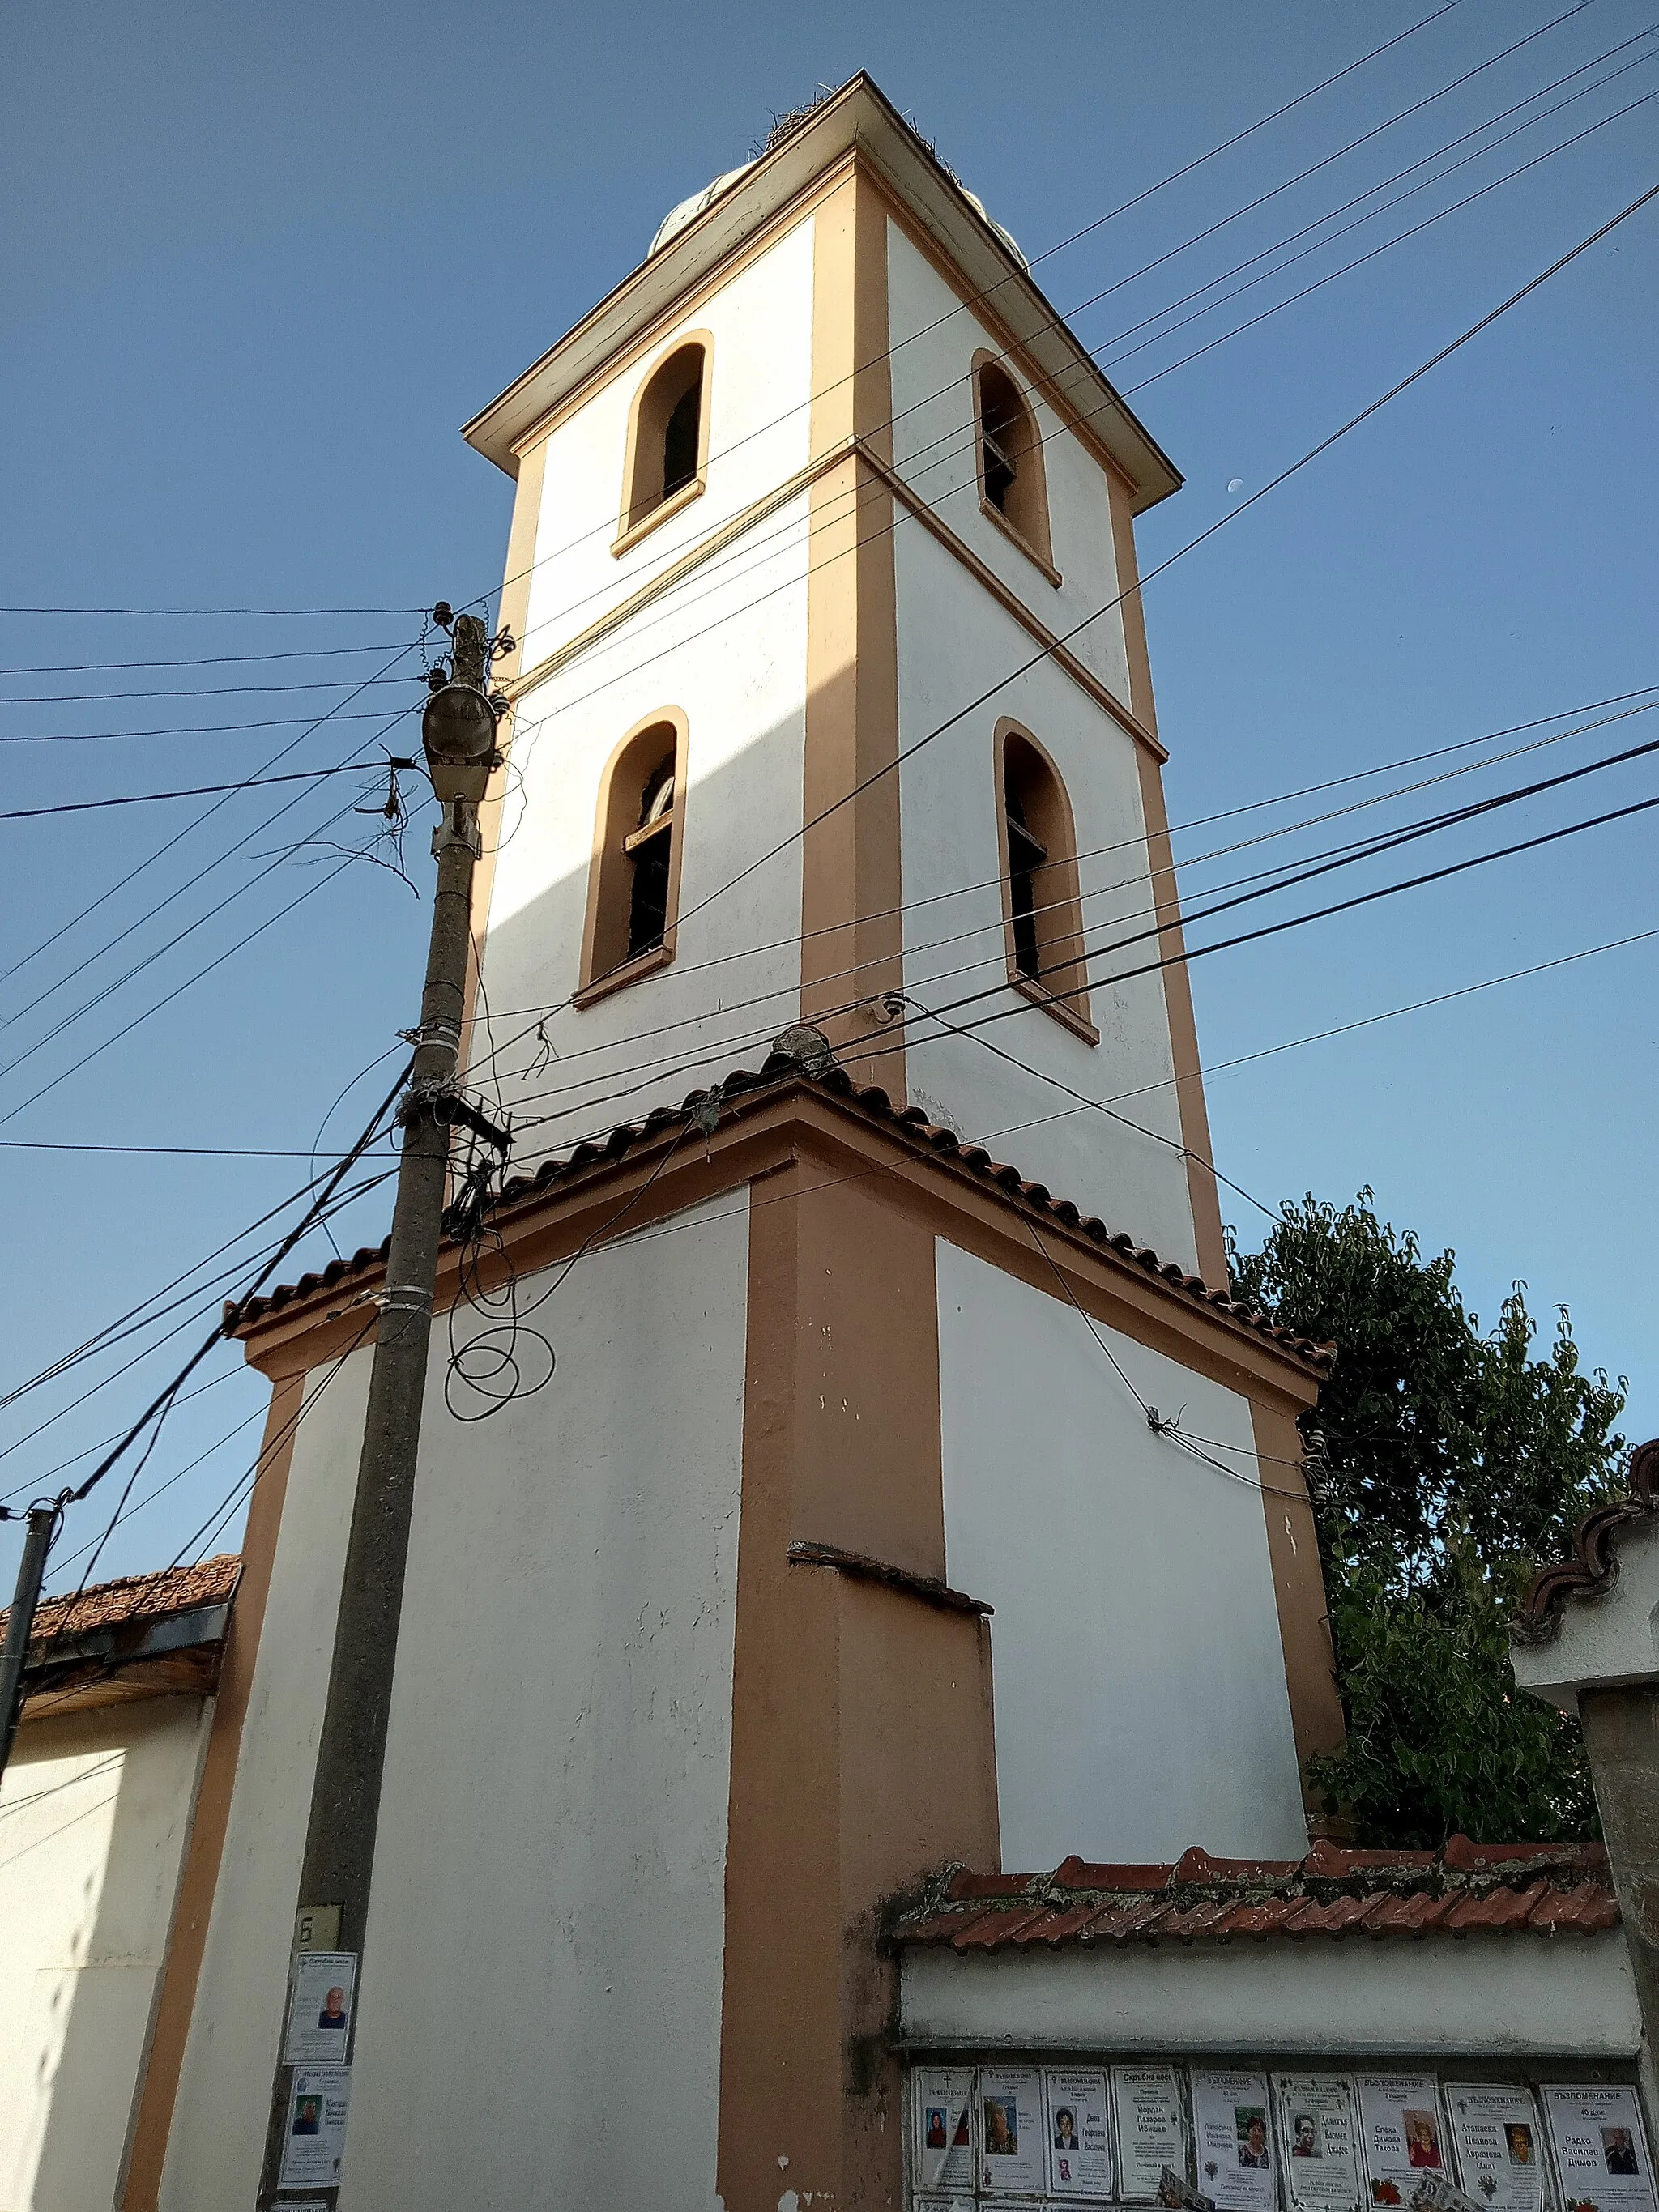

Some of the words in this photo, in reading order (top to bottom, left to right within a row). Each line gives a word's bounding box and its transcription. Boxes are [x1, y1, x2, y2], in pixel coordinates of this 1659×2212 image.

[1124, 2073, 1154, 2083] Скръбна
[1364, 2079, 1424, 2088] ВЪЗПОМЕНАНИЕ
[1554, 2092, 1622, 2100] ВЪЗПОМЕНАНИЕ
[1137, 2104, 1164, 2115] Йордан
[1137, 2115, 1166, 2124] Лазаров
[1375, 2125, 1397, 2133] Елена
[1461, 2123, 1497, 2133] Атанаска
[1374, 2135, 1401, 2144] Димова
[1565, 2136, 1592, 2146] Радко
[1562, 2147, 1600, 2156] Василев
[1568, 2158, 1598, 2168] Димов
